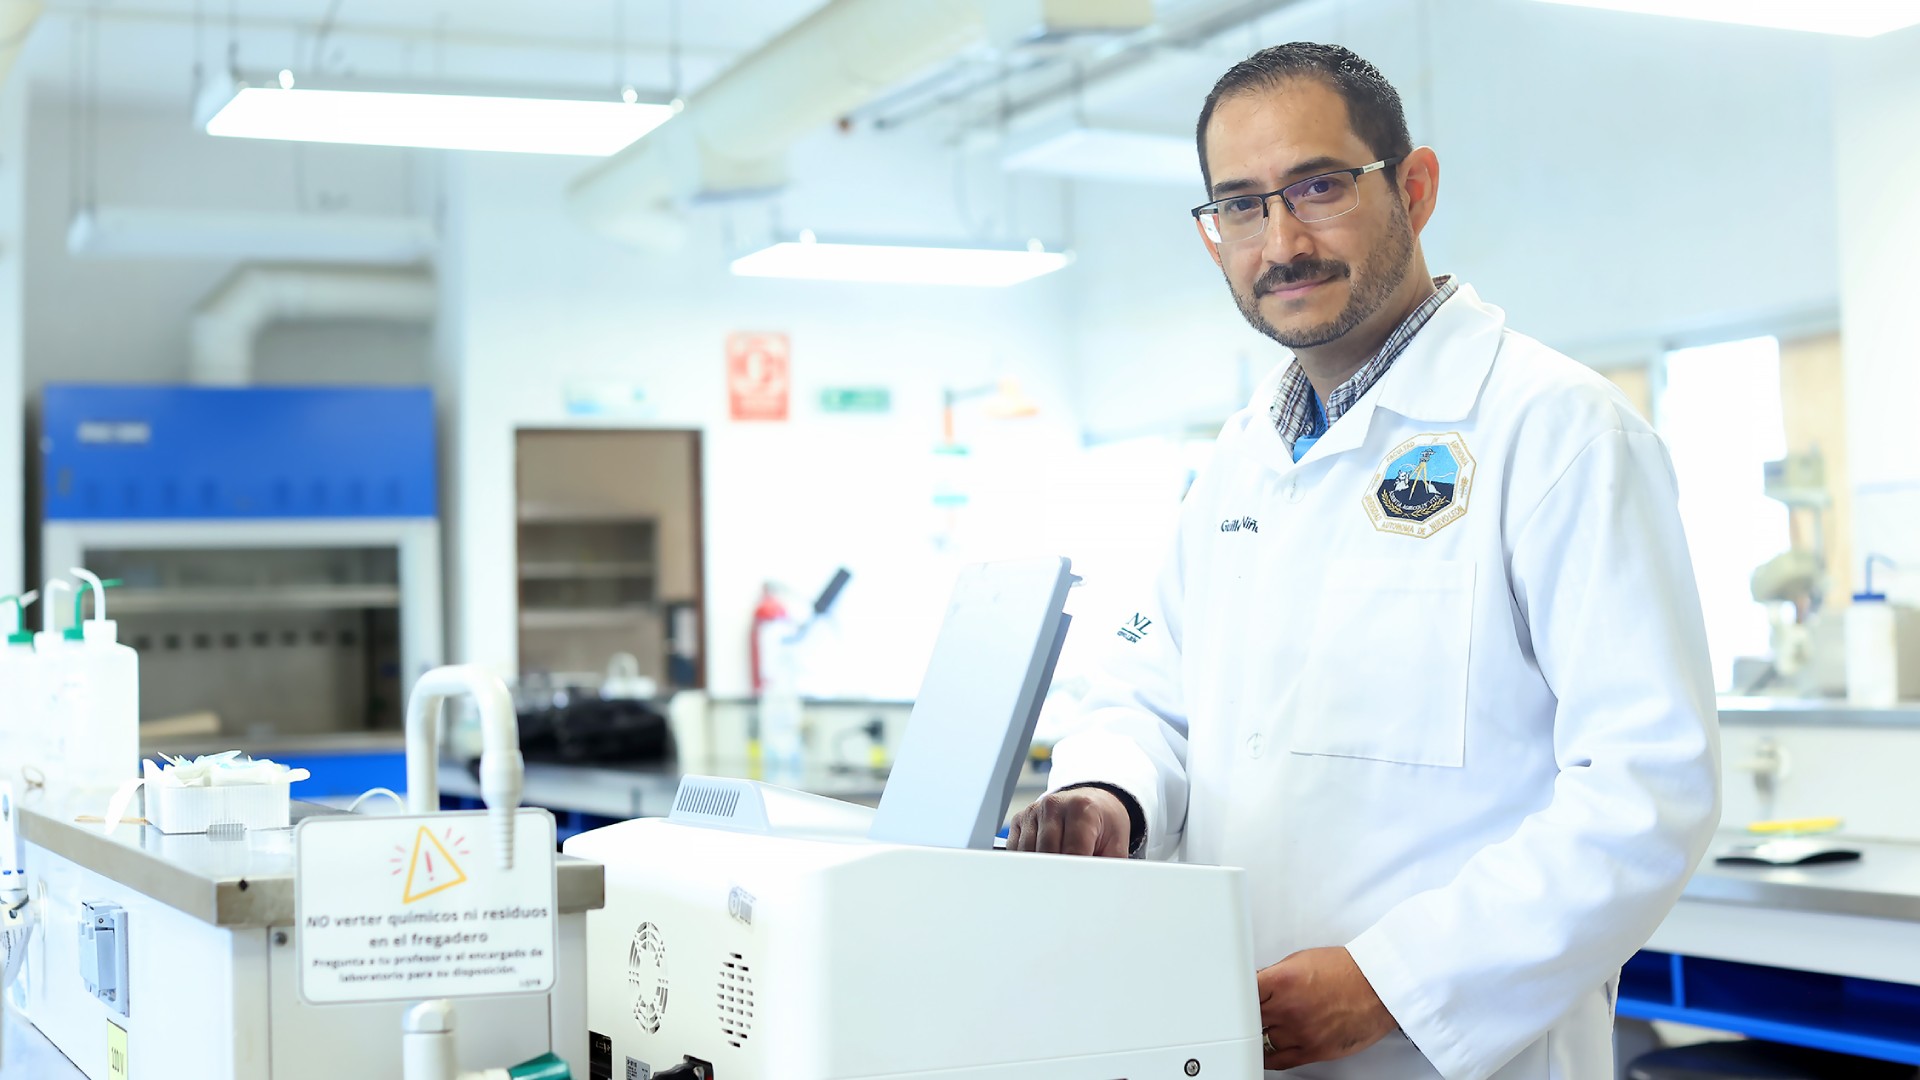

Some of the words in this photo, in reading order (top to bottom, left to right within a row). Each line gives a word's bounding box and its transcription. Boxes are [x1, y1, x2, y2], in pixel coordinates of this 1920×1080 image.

[306, 915, 330, 928] NO
[334, 915, 382, 926] verter
[387, 909, 458, 927] químicos
[464, 907, 478, 920] ni
[483, 906, 547, 919] residuos
[369, 937, 389, 948] en
[393, 933, 407, 947] el
[412, 931, 488, 949] fregadero
[394, 954, 441, 966] profesor
[468, 949, 526, 961] encargado
[531, 947, 543, 957] de
[339, 971, 403, 982] laboratorio
[407, 970, 433, 981] para
